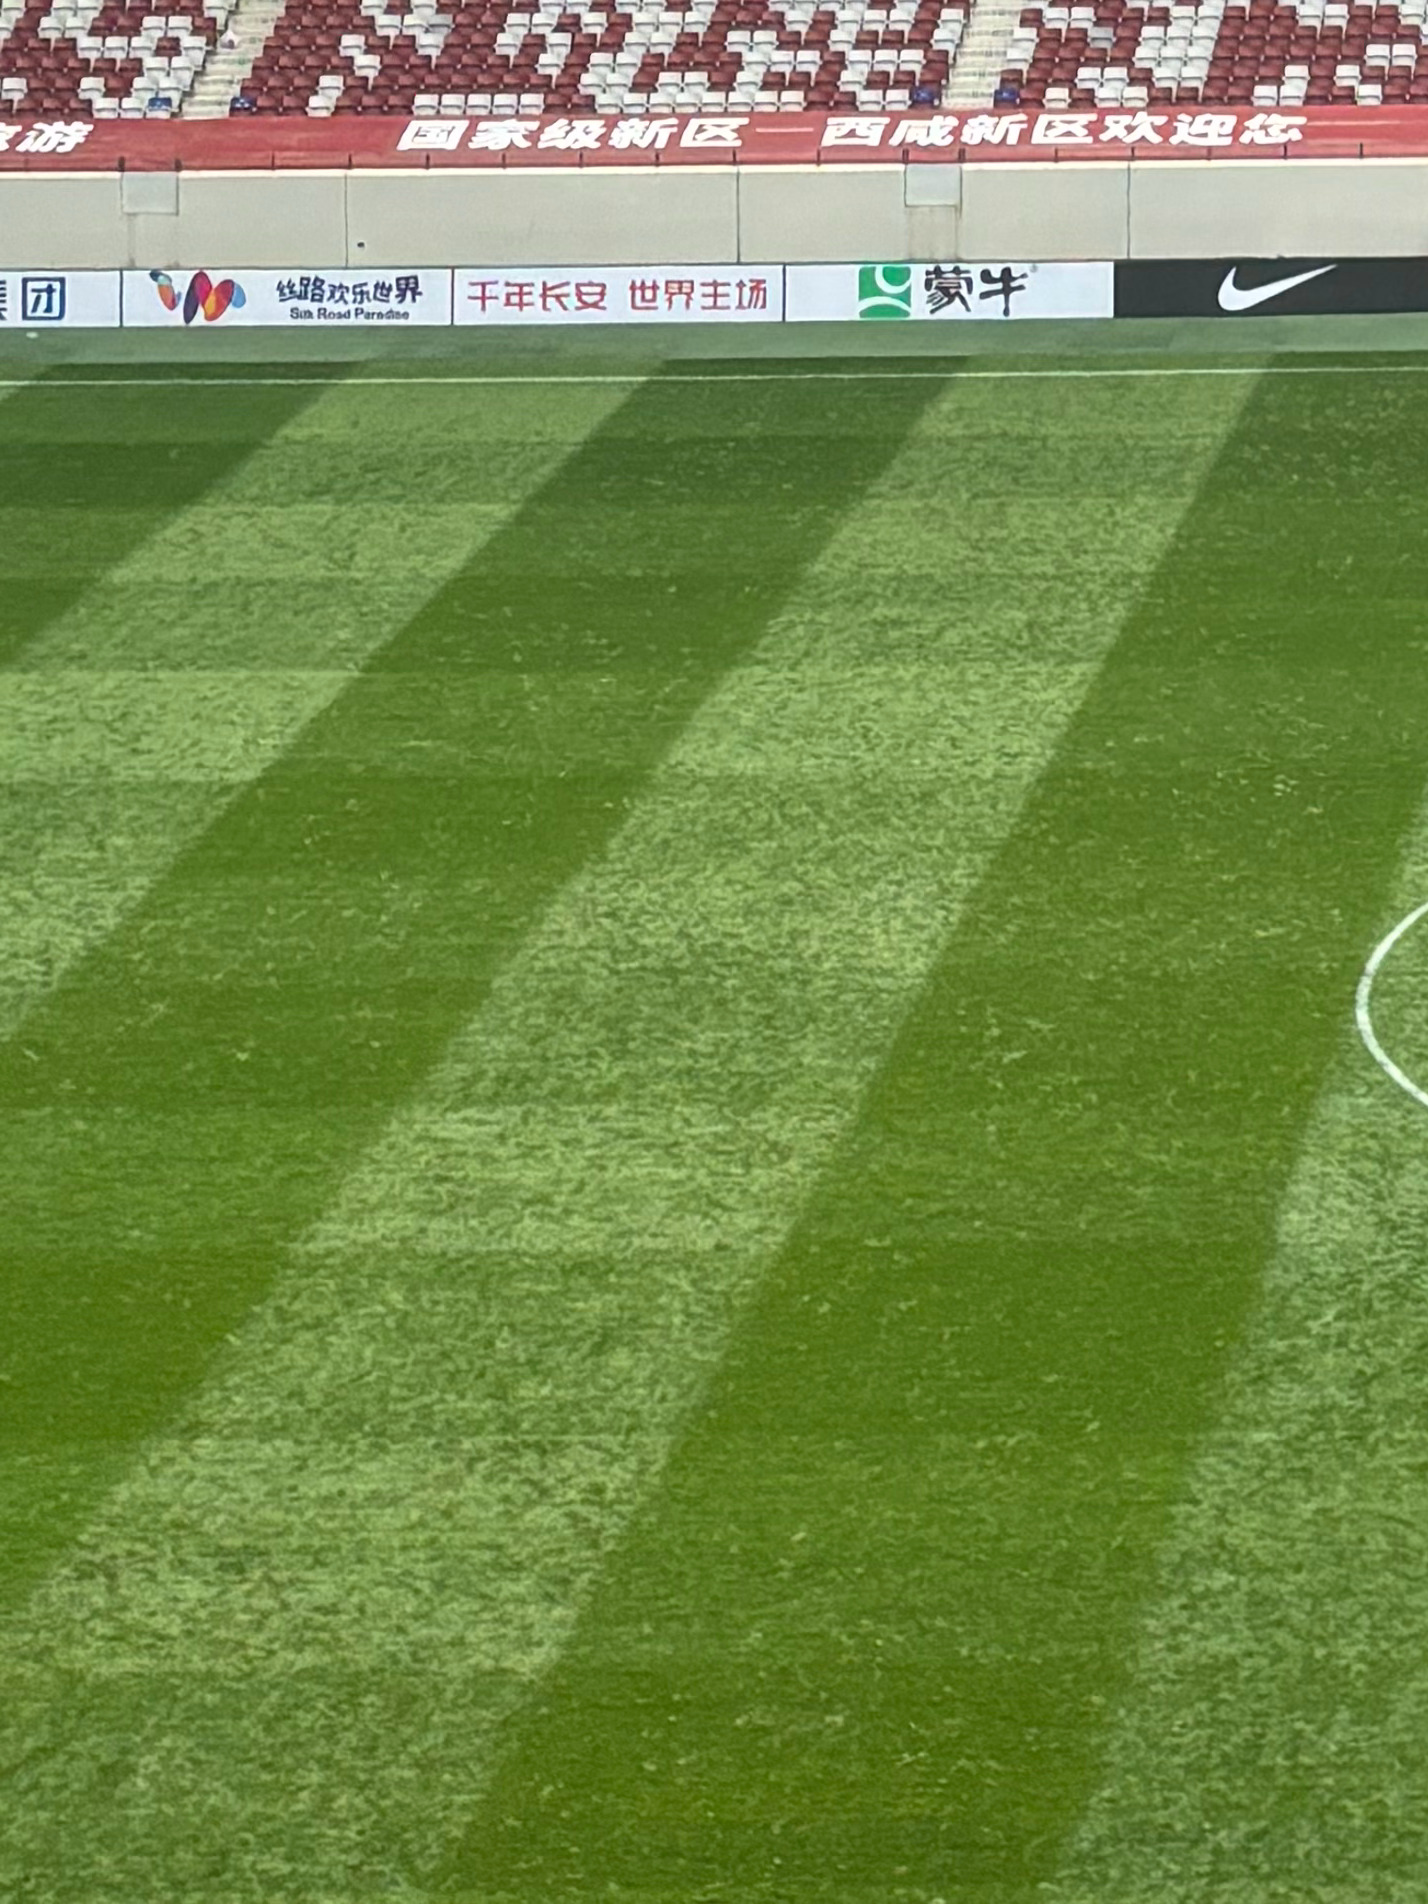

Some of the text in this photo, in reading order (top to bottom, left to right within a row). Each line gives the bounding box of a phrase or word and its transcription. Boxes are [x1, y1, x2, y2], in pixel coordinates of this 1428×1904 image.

[397, 117, 749, 150] 国家级新区
[820, 111, 1307, 146] 西咸新区欢迎您
[276, 275, 423, 305] 丝路欢乐世界
[467, 279, 767, 312] 千年长安 世界主场
[924, 265, 1029, 317] 蒙牛
[317, 307, 350, 319] Road
